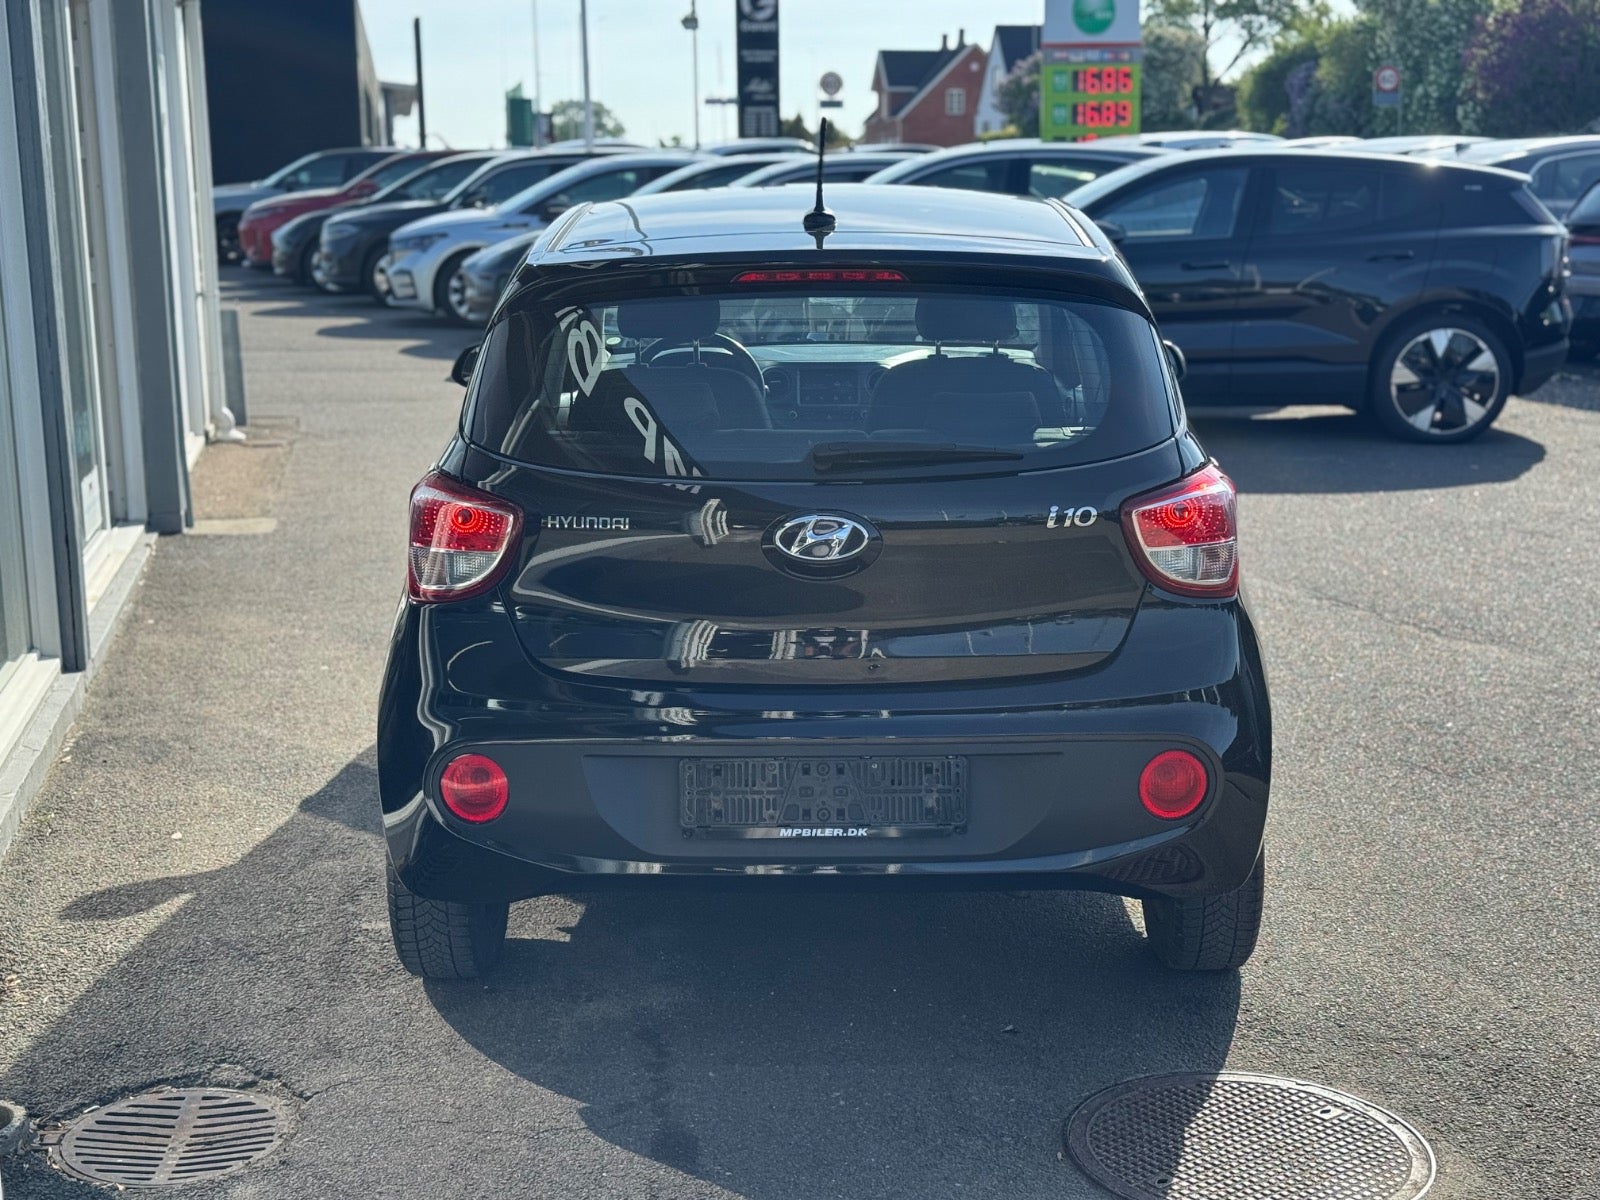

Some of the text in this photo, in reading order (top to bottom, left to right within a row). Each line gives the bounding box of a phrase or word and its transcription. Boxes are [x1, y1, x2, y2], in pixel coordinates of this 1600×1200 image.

[547, 515, 630, 530] HYUNDAI
[1046, 505, 1098, 529] i10
[779, 827, 868, 838] MPBILER.DK
